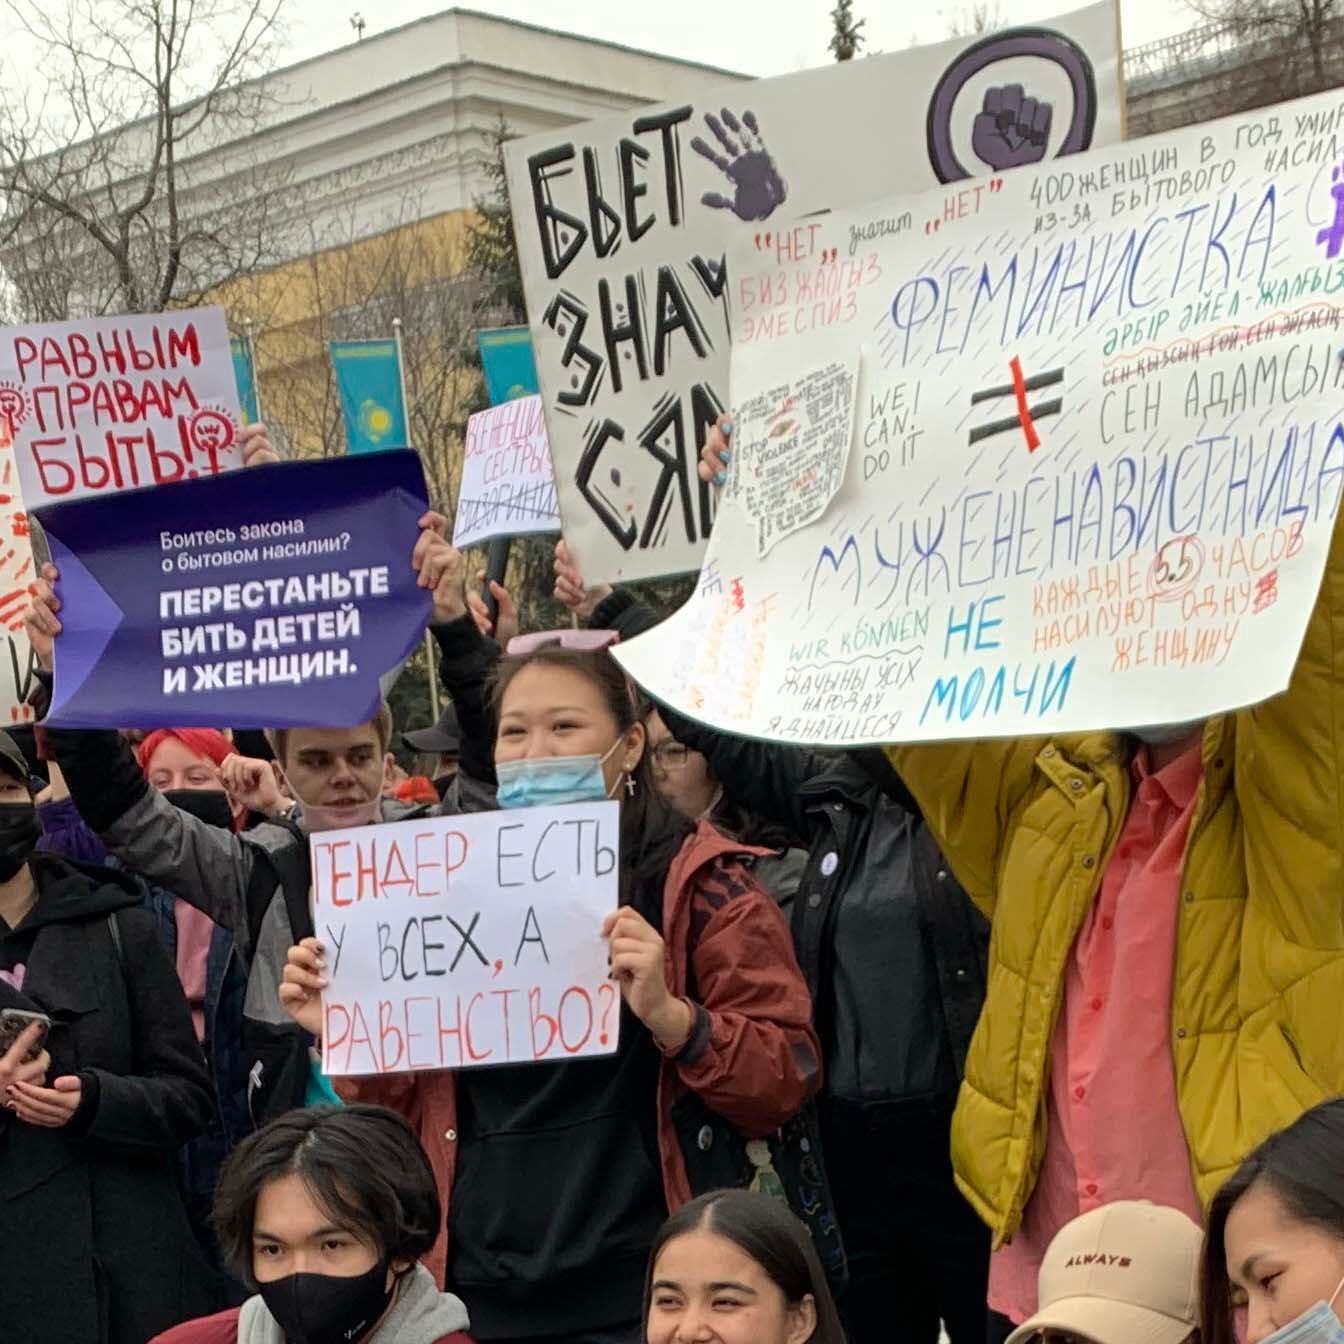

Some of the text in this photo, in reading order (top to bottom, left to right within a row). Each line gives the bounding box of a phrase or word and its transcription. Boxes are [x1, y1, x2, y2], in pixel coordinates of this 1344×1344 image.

[1201, 136, 1216, 164] В
[1236, 117, 1282, 150] ГОД
[528, 105, 694, 279] БЬЕТ
[1111, 160, 1236, 218] БЫТОВОГО
[740, 274, 788, 311] БИЗ
[891, 183, 1277, 368] ФЕМИНИСТКА
[14, 322, 201, 383] РАВНЫМ
[33, 376, 199, 433] ПРАВАМ
[31, 415, 199, 494] БЫТЬ!
[864, 431, 924, 480] DO IT
[160, 519, 304, 551] Боитесь закона
[161, 532, 351, 573] о бытовом насилии?
[159, 565, 390, 619] ПЕРЕСТАНЬТЕ
[1033, 553, 1141, 618] КАЖДЫЕ
[1212, 519, 1305, 580] ЧАСОВ
[161, 603, 360, 657] БИТЬ ДЕТЕЙ
[944, 596, 1006, 658] НЕ
[1034, 594, 1159, 654] НАСИЛУЮТ
[1110, 622, 1240, 673] ЖЕНЩИНУ
[163, 649, 357, 694] И ЖЕНЩИН.
[919, 656, 1077, 727] МОЛЧИ
[314, 818, 616, 907] ГЕНДЕР ЕСТЬ
[326, 905, 550, 982] У ВСЕХ, А
[324, 983, 616, 1074] РАВЕНСТВО?
[1065, 1253, 1133, 1268] ALWAYS
